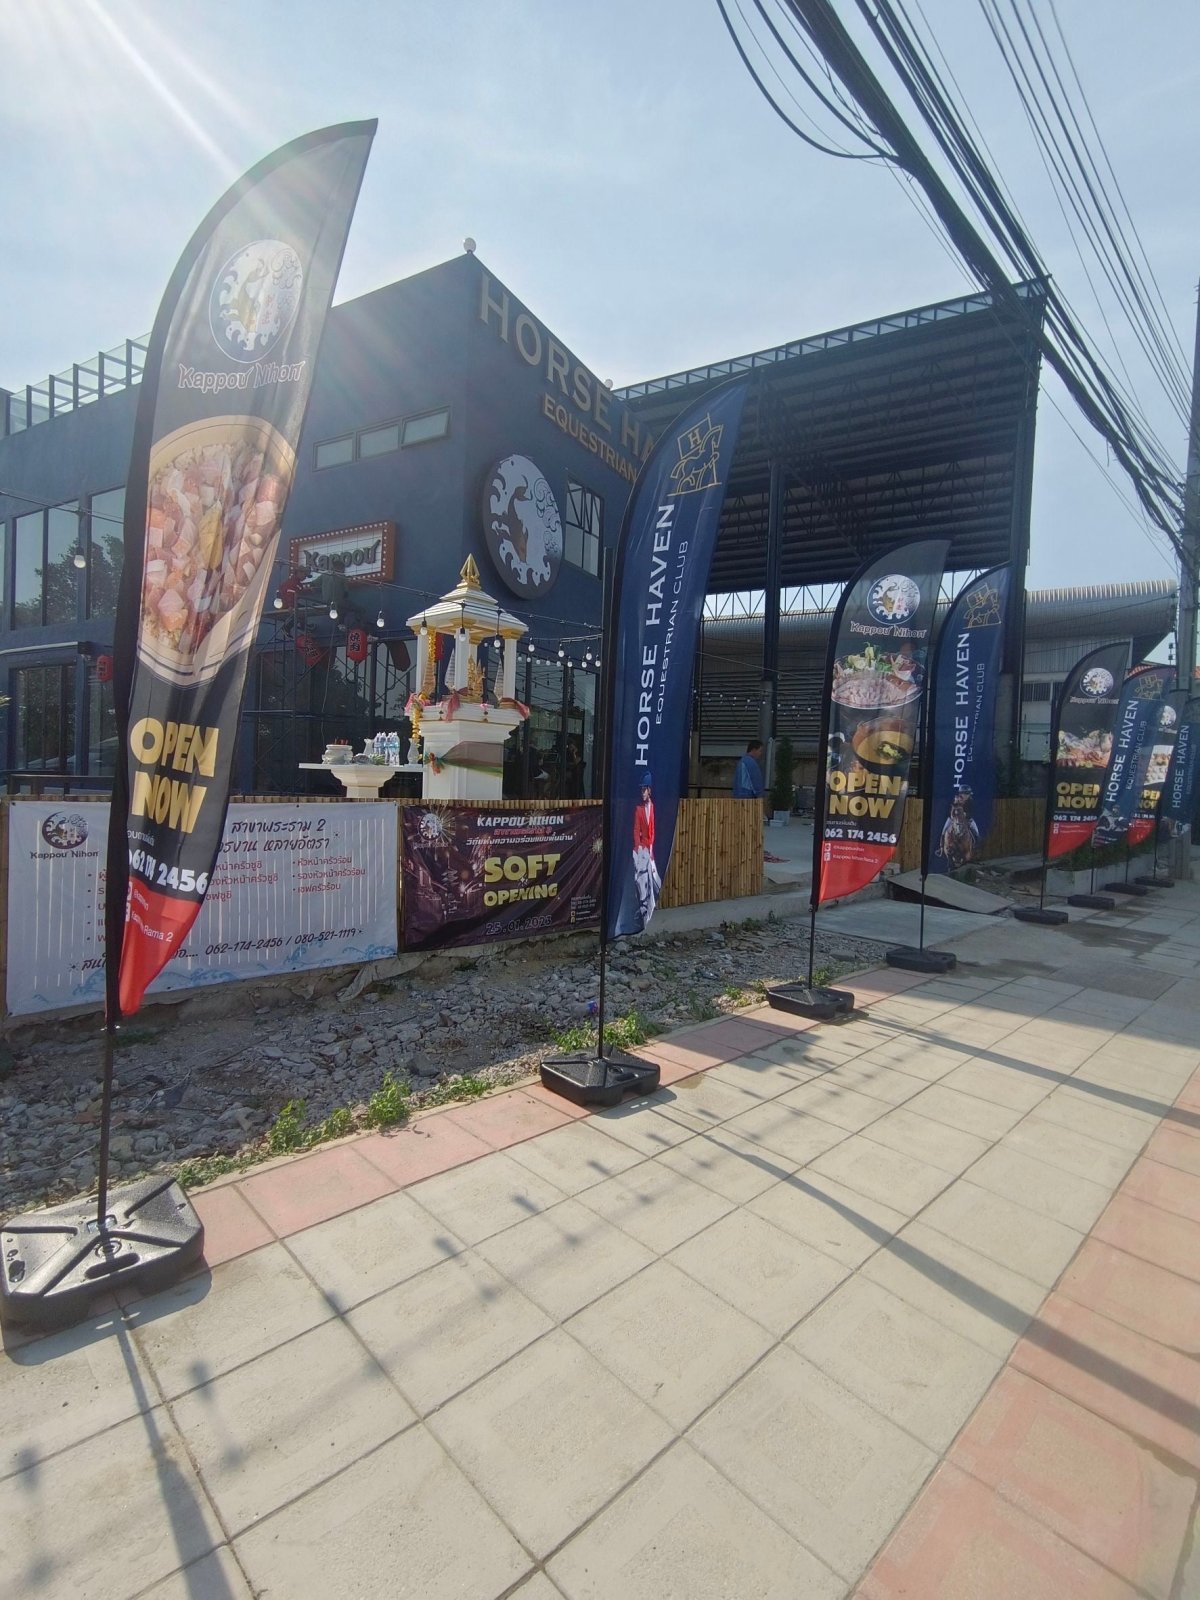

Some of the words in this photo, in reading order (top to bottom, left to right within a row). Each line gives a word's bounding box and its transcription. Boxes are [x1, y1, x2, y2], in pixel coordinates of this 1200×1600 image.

[479, 270, 613, 433] HORSE
[178, 363, 255, 394] Kappou
[253, 360, 306, 389] Nihon
[543, 392, 638, 484] EQUESTRIAN
[645, 504, 675, 626] HAVEN
[656, 600, 679, 724] EQUESTRIAN
[673, 540, 689, 595] CLUB
[850, 620, 894, 636] Kappou
[893, 624, 928, 639] Nihon
[956, 633, 970, 706] HAVEN
[976, 663, 985, 693] CLUB
[635, 644, 658, 766] HORSE
[130, 717, 219, 777] OPEN
[953, 716, 969, 788] HORSE
[1105, 754, 1126, 802] HORSE
[1118, 700, 1139, 748] HAVEN
[1176, 725, 1190, 764] HAVEN
[829, 770, 902, 796] OPEN
[1172, 769, 1185, 808] HORSE
[131, 770, 207, 834] NOW
[829, 794, 895, 819] NOW
[1057, 795, 1099, 809] NOW
[231, 820, 312, 834] สาขาพระราม
[316, 818, 327, 832] 2
[477, 815, 525, 827] KAPPOU
[528, 815, 564, 826] NIHON
[825, 827, 843, 838] 062
[847, 829, 864, 840] 174
[867, 831, 897, 844] 2456
[30, 850, 69, 860] Kappou
[70, 850, 99, 858] Nihon
[263, 835, 330, 851] หลายอัตรา
[157, 863, 209, 895] 2456
[485, 854, 561, 883] SOFT
[484, 883, 558, 907] OPENING
[143, 925, 164, 940] Rama
[165, 931, 174, 942] 2
[205, 938, 283, 956] 062-174-2456
[285, 936, 291, 946] /
[294, 928, 356, 945] 080-521-1119
